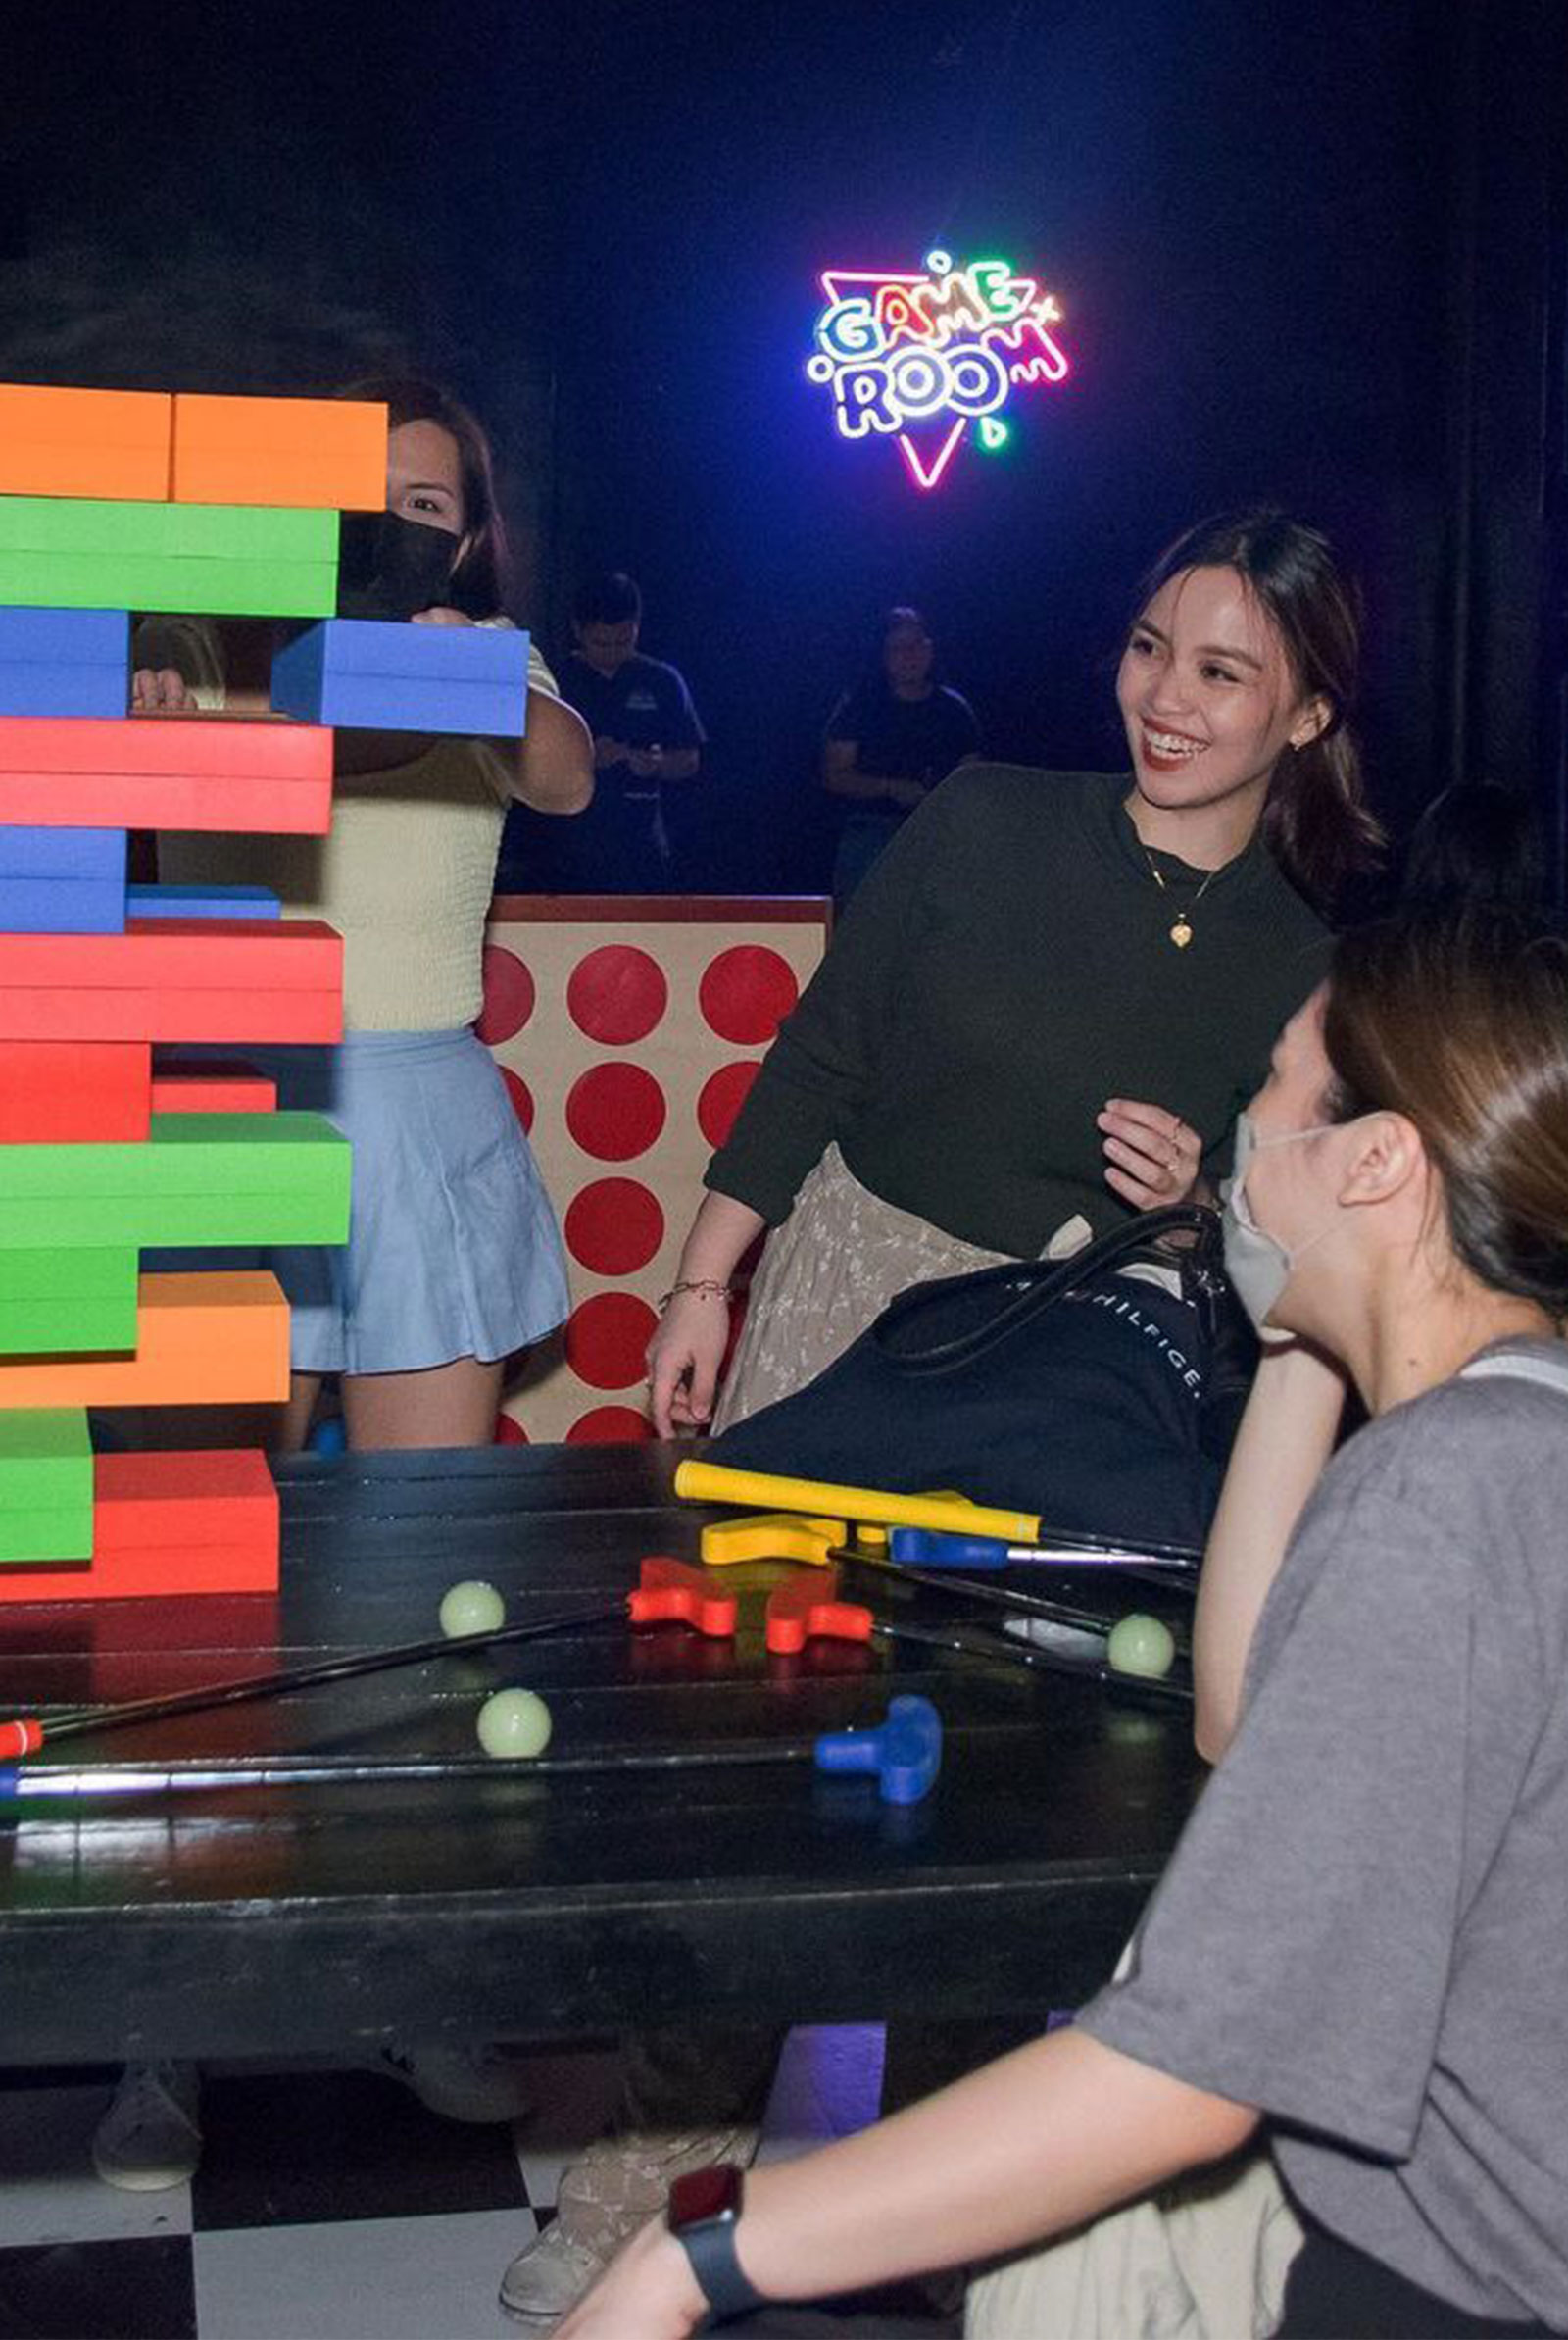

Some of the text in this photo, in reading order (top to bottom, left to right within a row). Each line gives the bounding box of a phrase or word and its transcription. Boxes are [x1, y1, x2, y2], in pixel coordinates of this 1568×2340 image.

[819, 260, 1020, 362] GAME
[834, 316, 1068, 438] ROOM
[1092, 1294, 1200, 1399] HILFIGE
